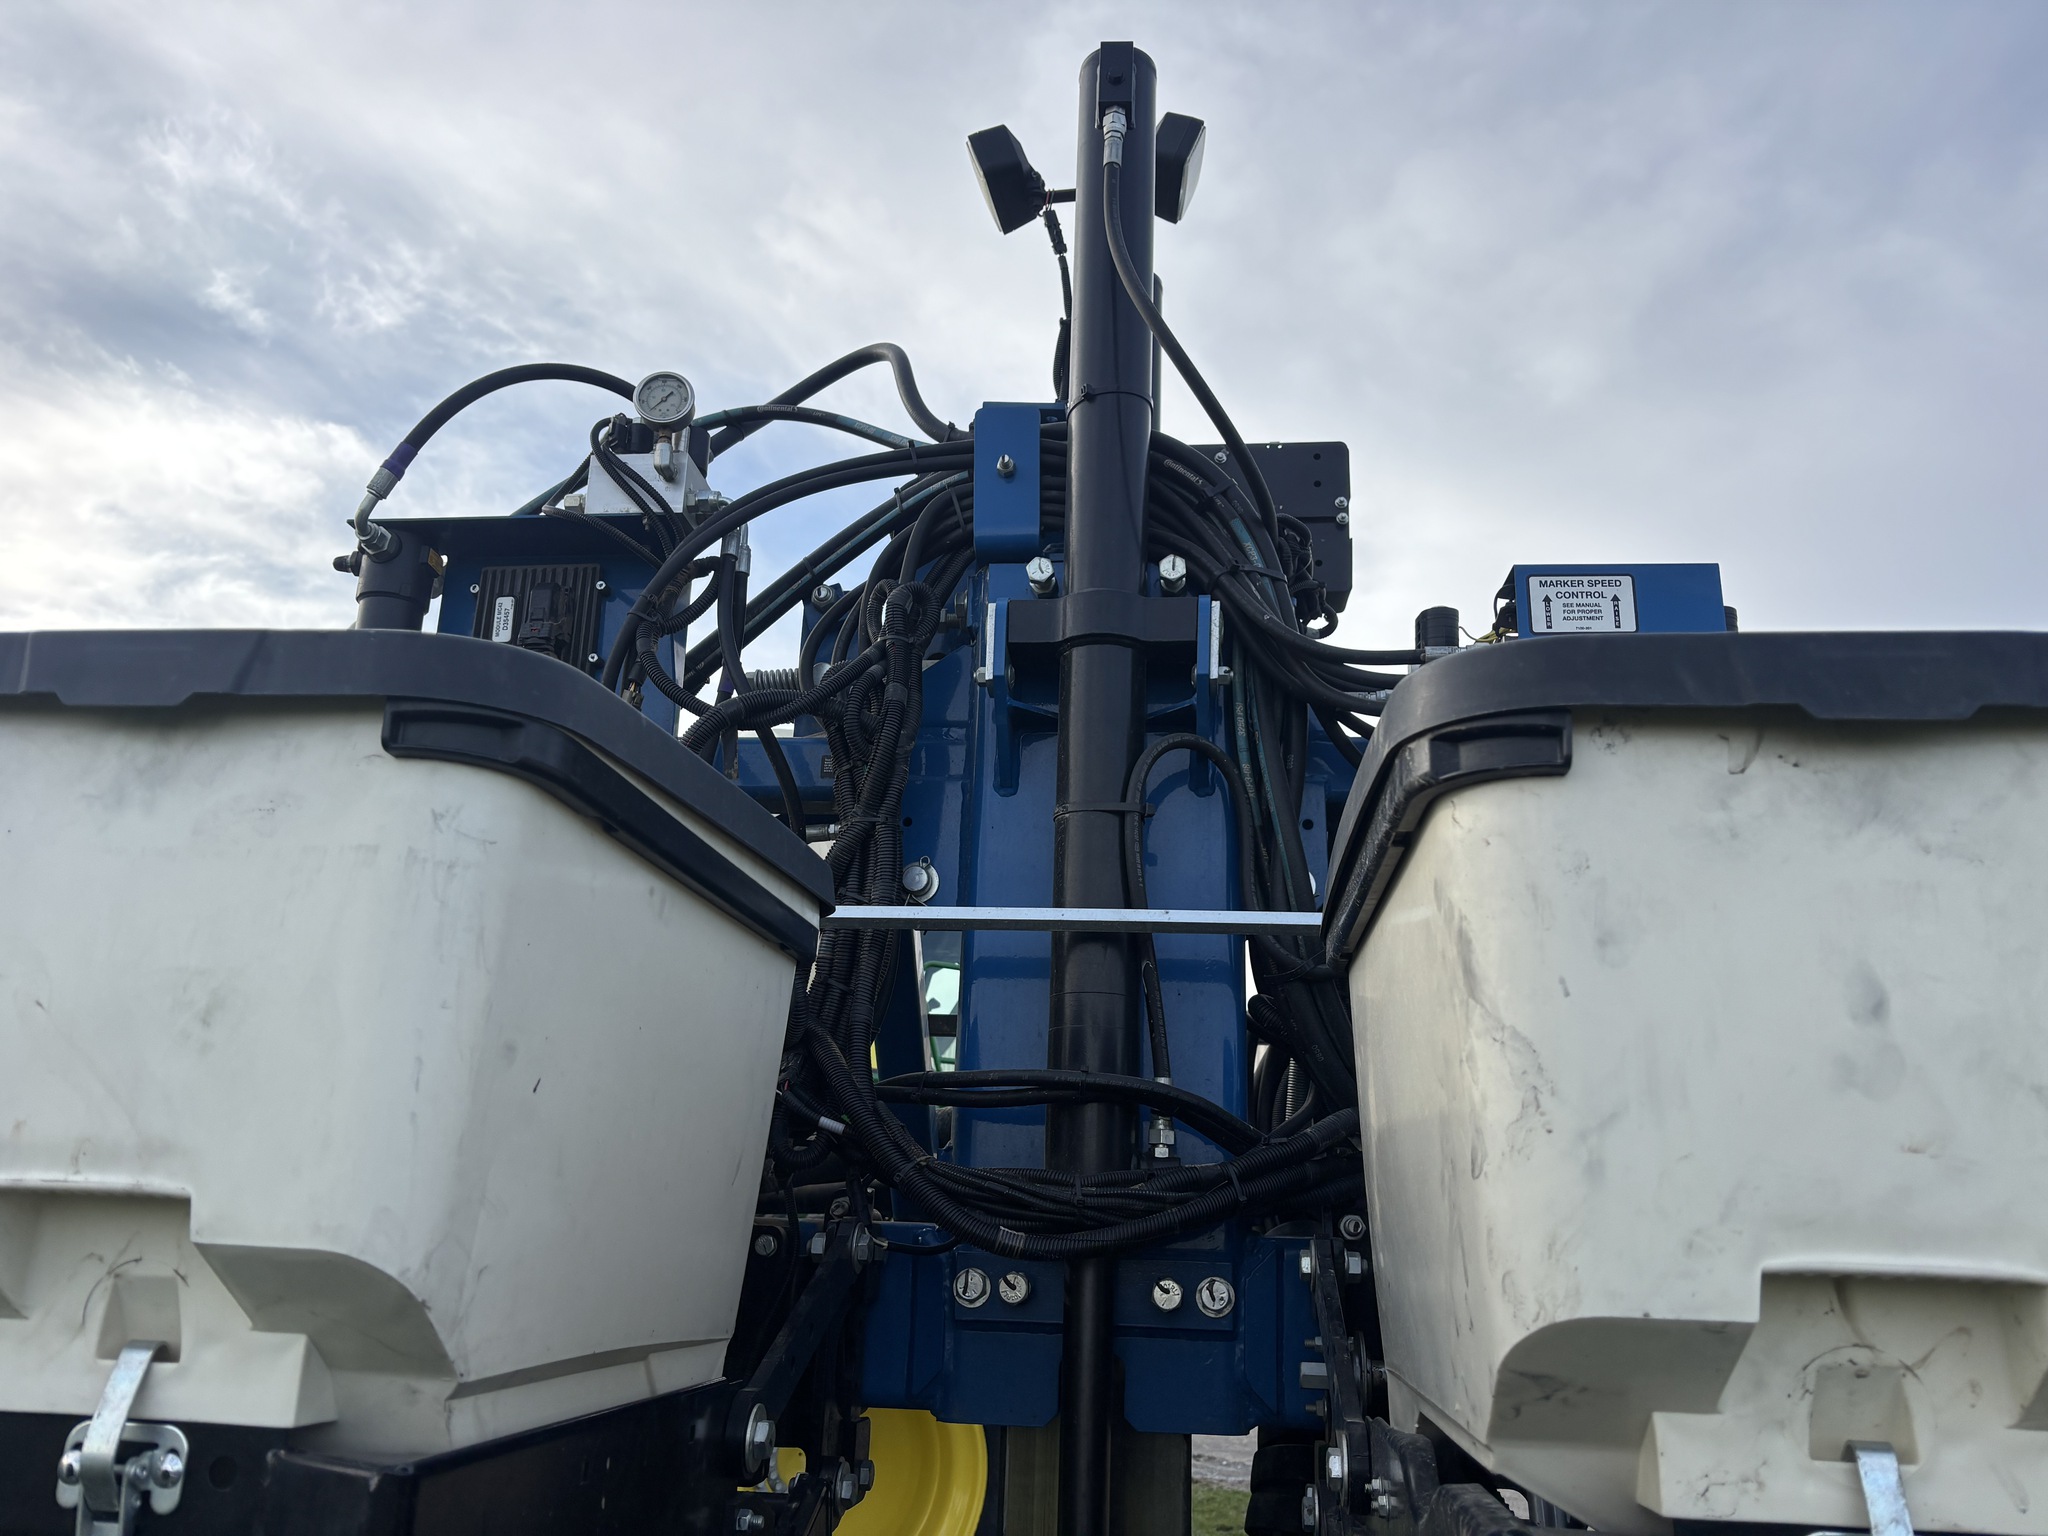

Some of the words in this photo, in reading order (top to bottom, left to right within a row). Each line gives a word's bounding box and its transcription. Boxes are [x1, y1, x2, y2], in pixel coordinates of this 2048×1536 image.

[1243, 541, 1261, 568] XCP3-0
[1587, 579, 1621, 587] SPEED
[1556, 591, 1607, 599] CONTROL
